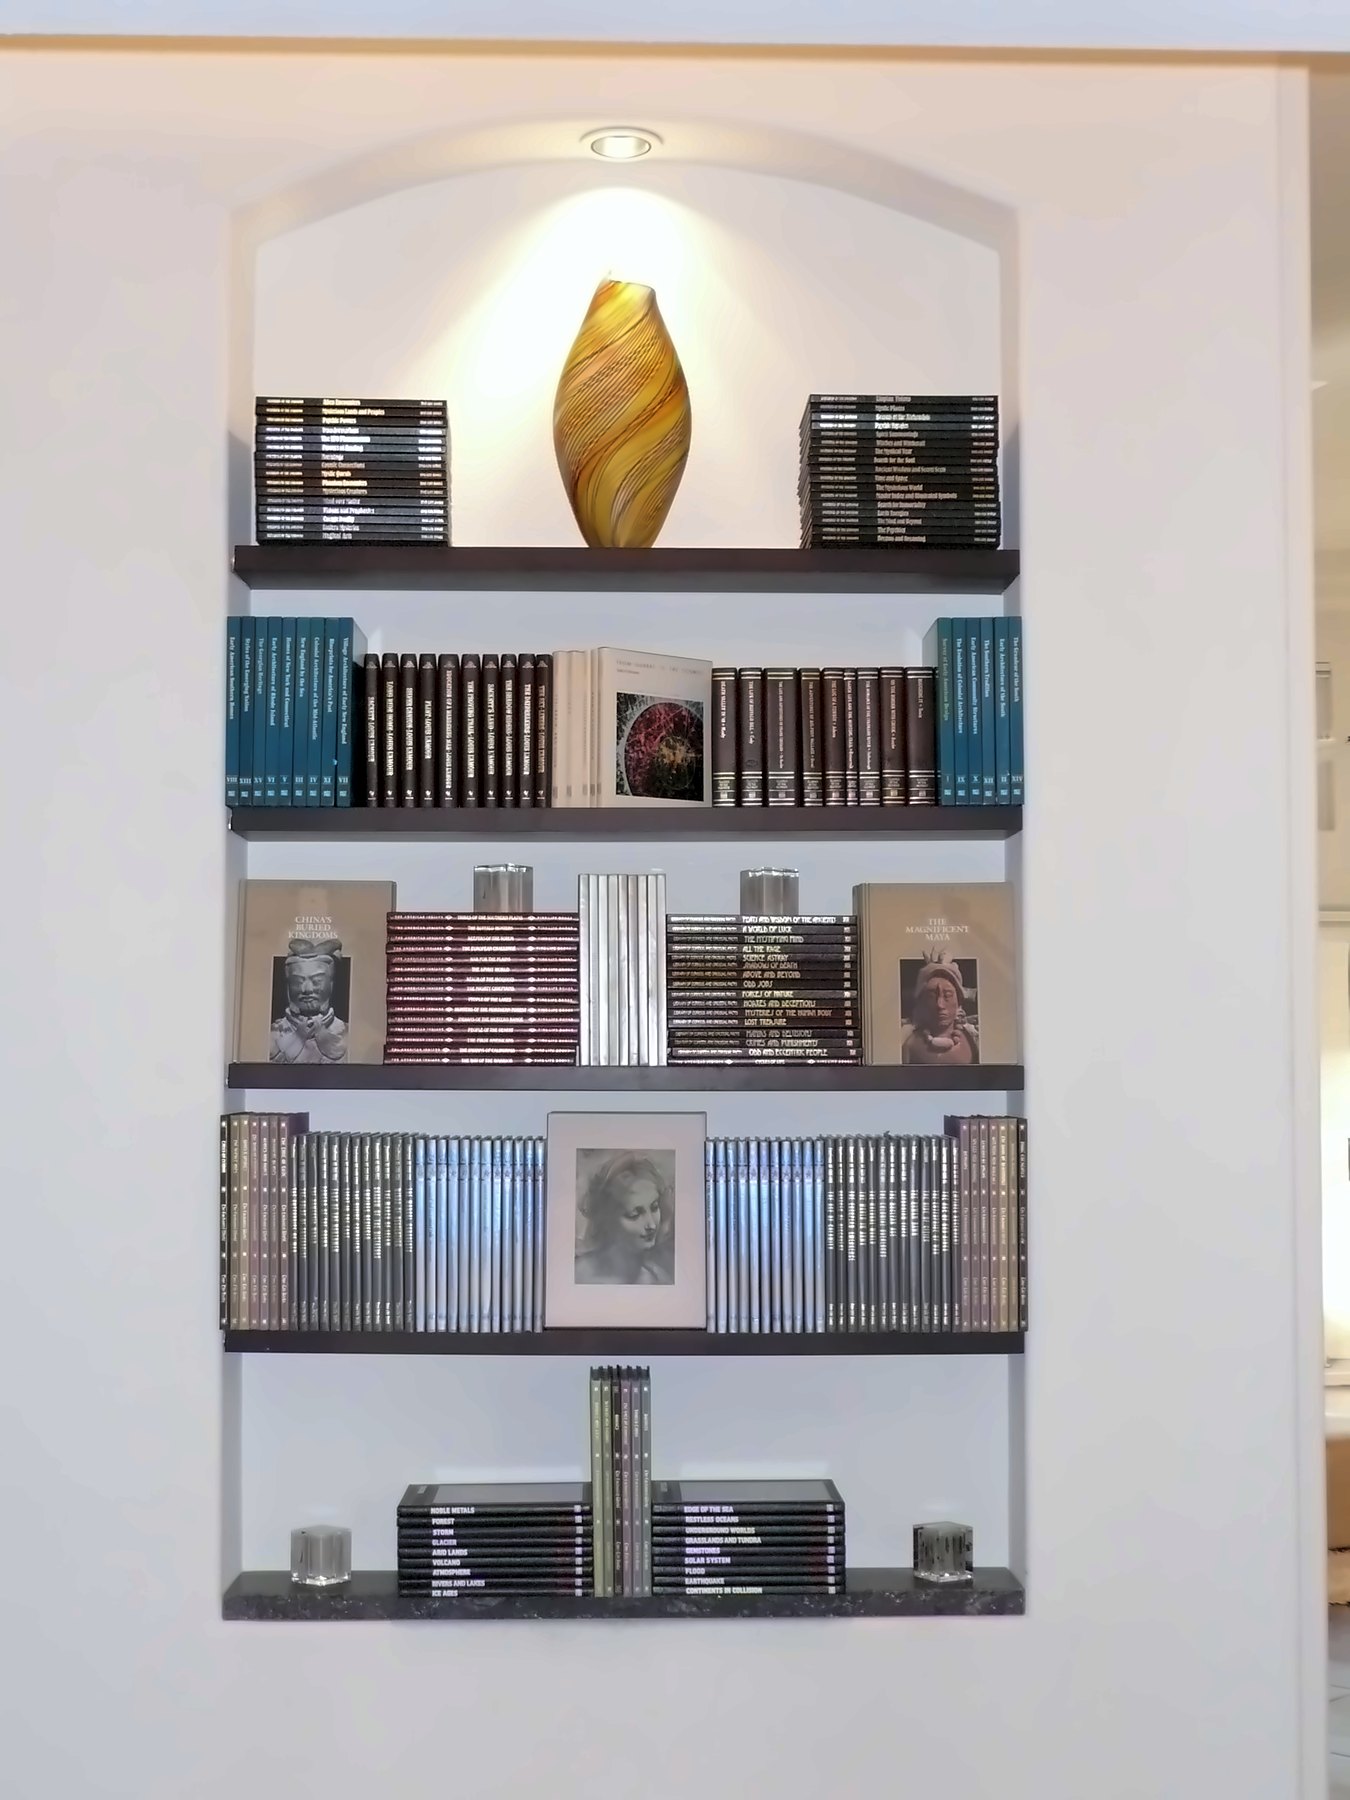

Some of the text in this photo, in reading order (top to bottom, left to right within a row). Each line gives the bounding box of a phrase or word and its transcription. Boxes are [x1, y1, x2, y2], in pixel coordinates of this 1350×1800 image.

[295, 916, 332, 924] CHINA'S
[906, 925, 970, 934] MAGNIFICENT
[288, 931, 338, 939] KINGDOMS
